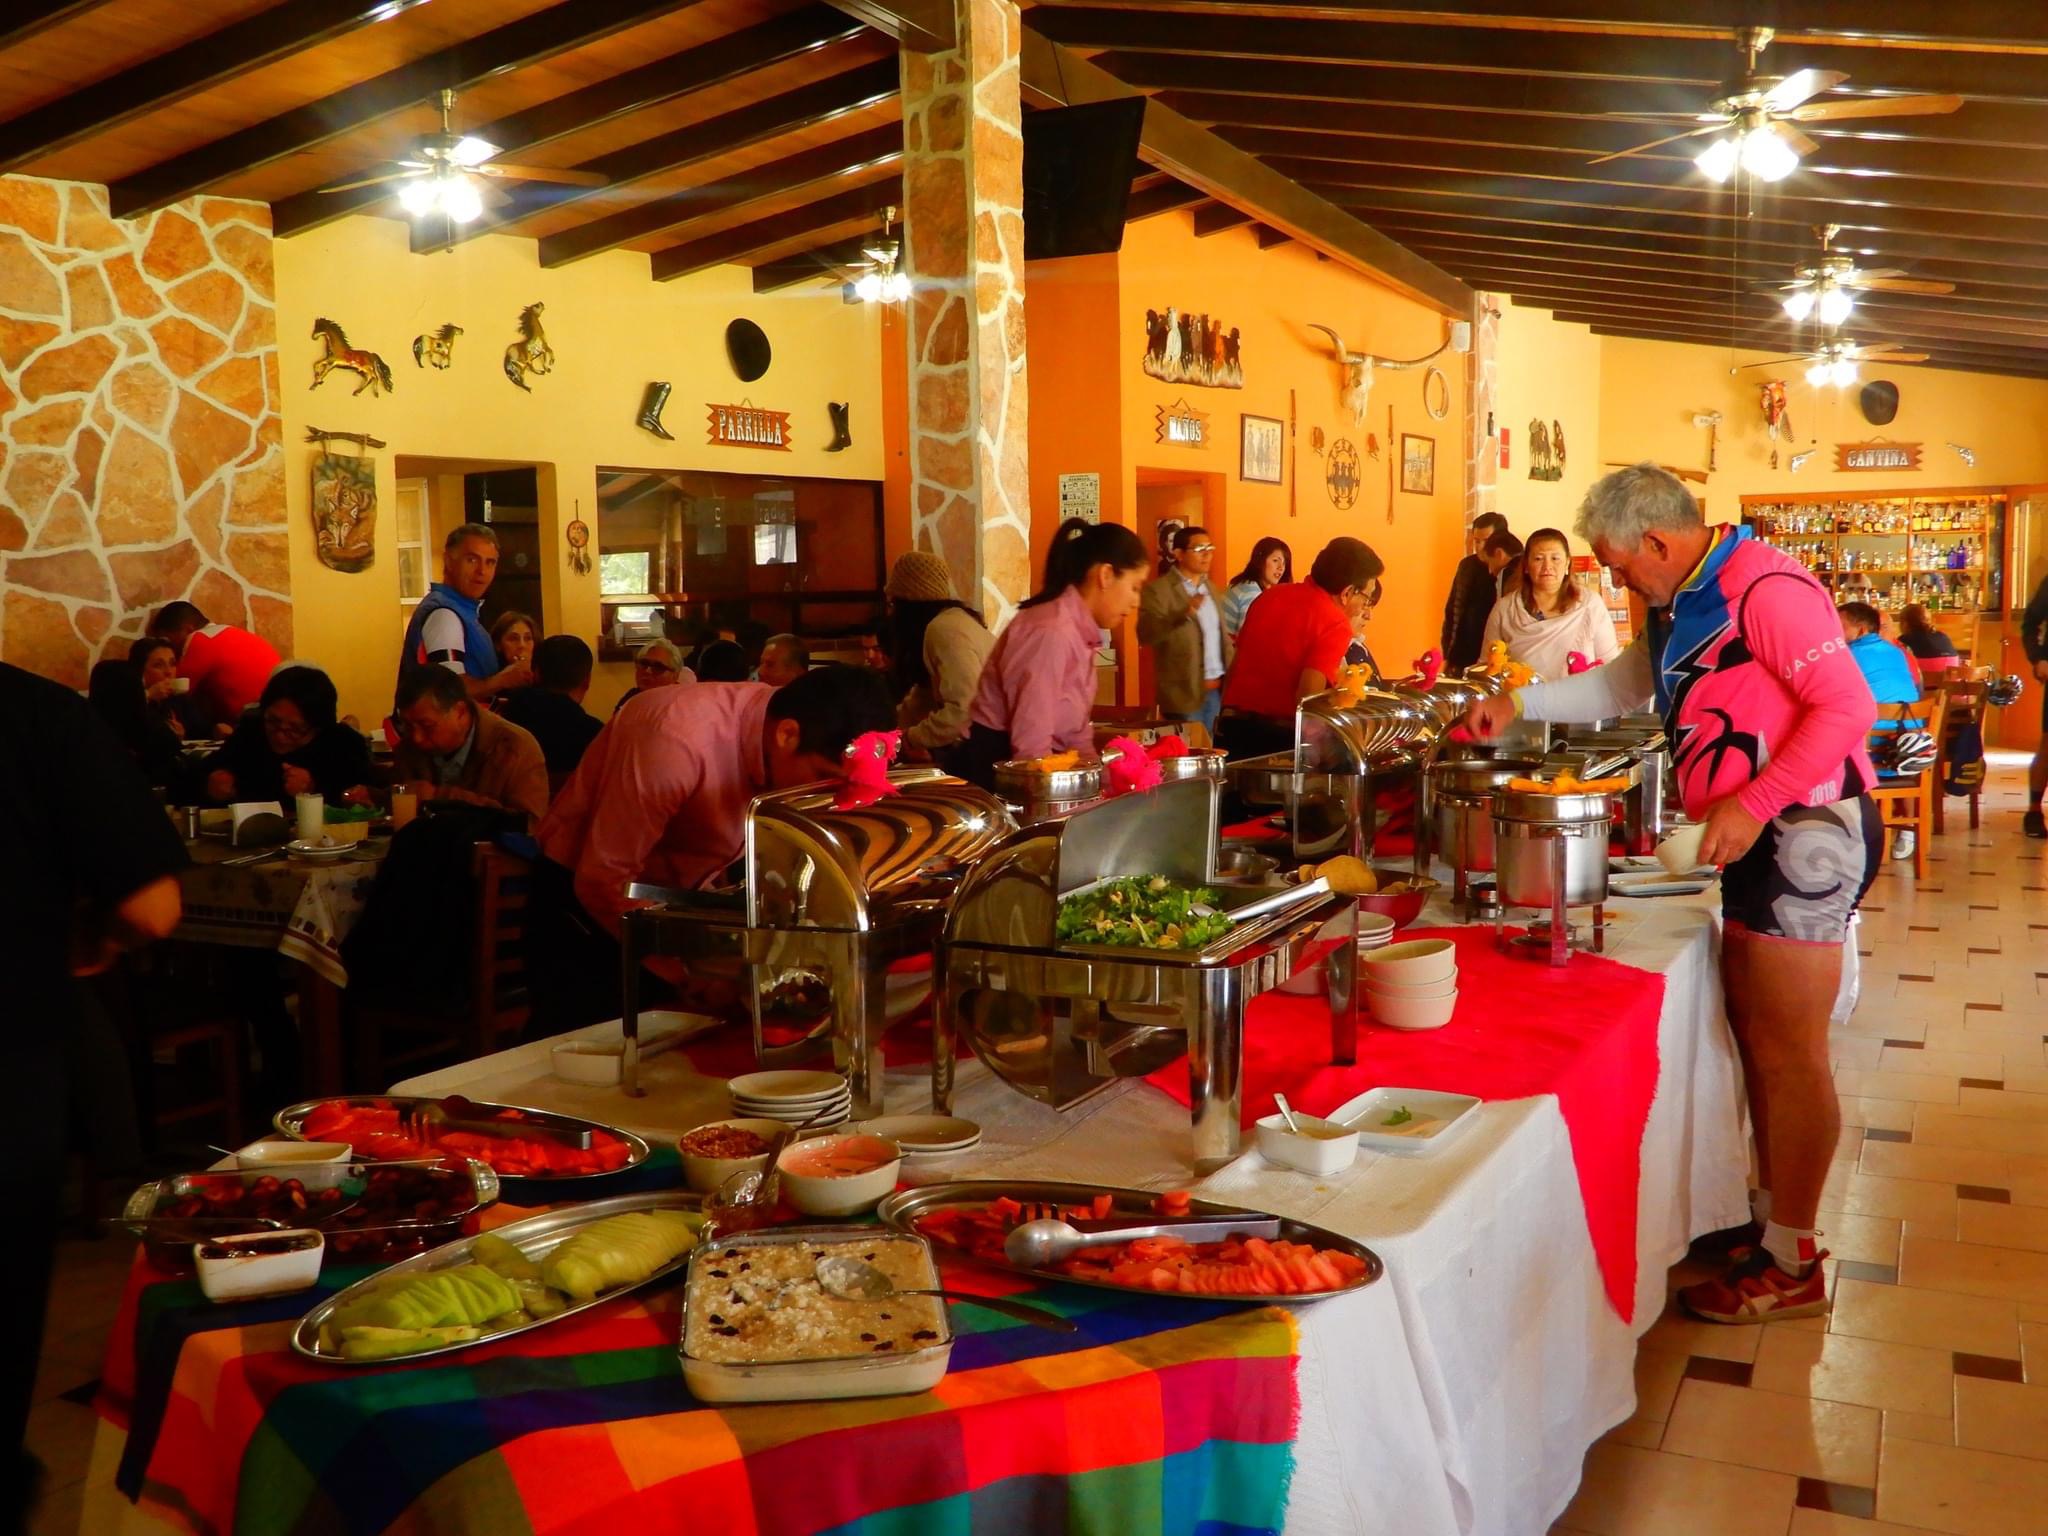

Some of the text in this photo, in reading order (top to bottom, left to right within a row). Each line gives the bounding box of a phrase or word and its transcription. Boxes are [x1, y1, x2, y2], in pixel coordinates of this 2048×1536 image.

[719, 408, 783, 445] PARRILLA
[1847, 449, 1909, 467] CANTINA
[1808, 780, 1837, 807] 2018
